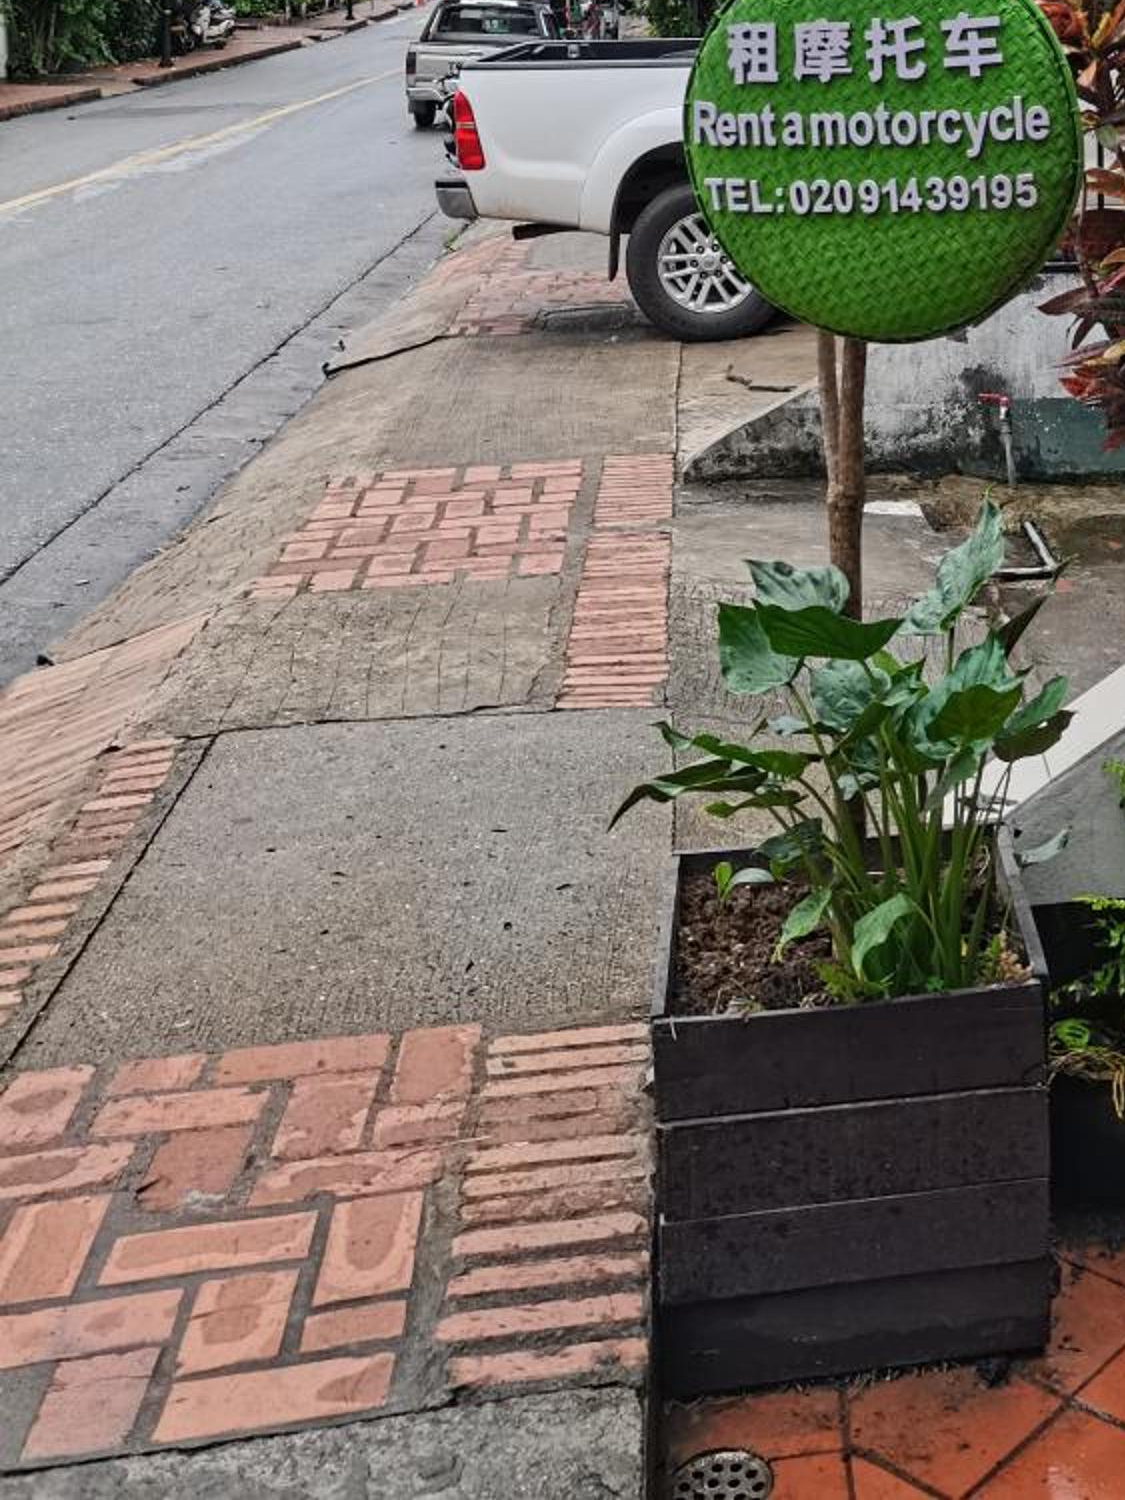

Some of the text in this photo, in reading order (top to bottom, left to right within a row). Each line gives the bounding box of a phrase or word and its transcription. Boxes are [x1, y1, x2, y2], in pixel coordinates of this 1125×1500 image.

[726, 12, 1003, 85] 租摩托车
[693, 96, 1050, 159] Rent a motorcycle
